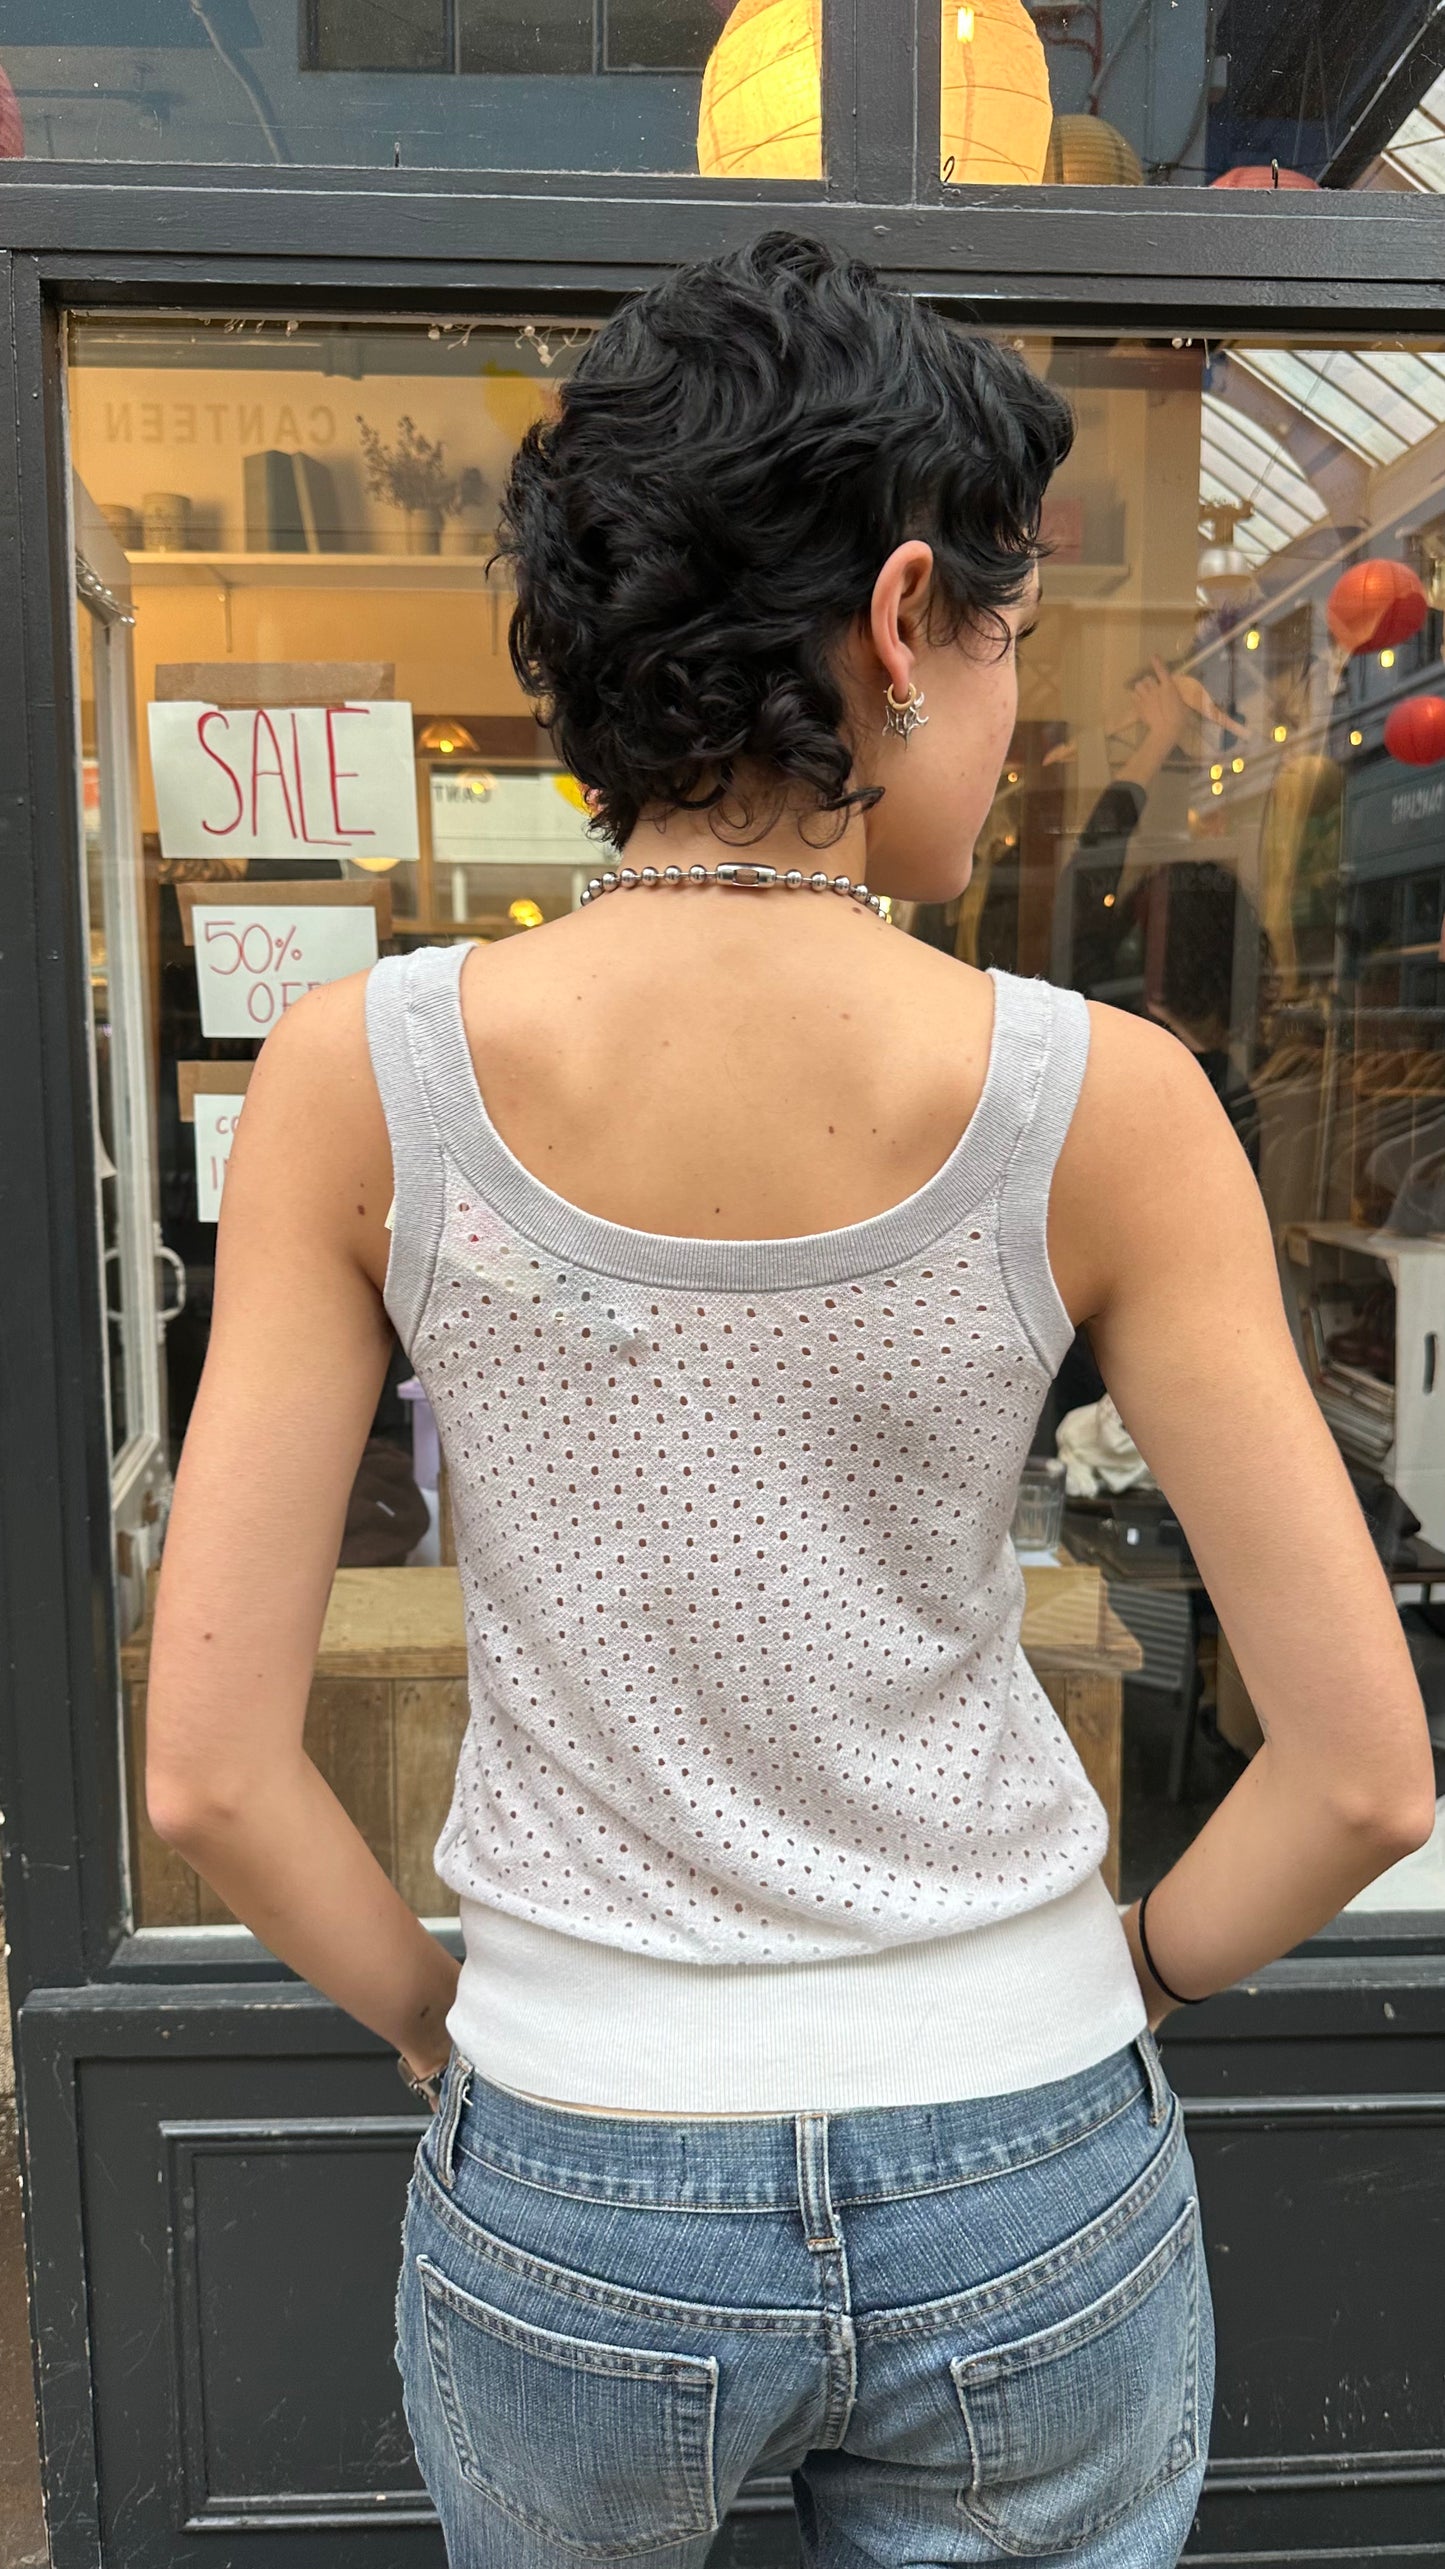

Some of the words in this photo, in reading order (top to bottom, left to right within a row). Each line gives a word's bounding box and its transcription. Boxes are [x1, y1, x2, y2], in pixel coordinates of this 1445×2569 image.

[197, 708, 376, 846] SALE
[205, 921, 302, 975] 50%
[247, 982, 321, 1023] OF
